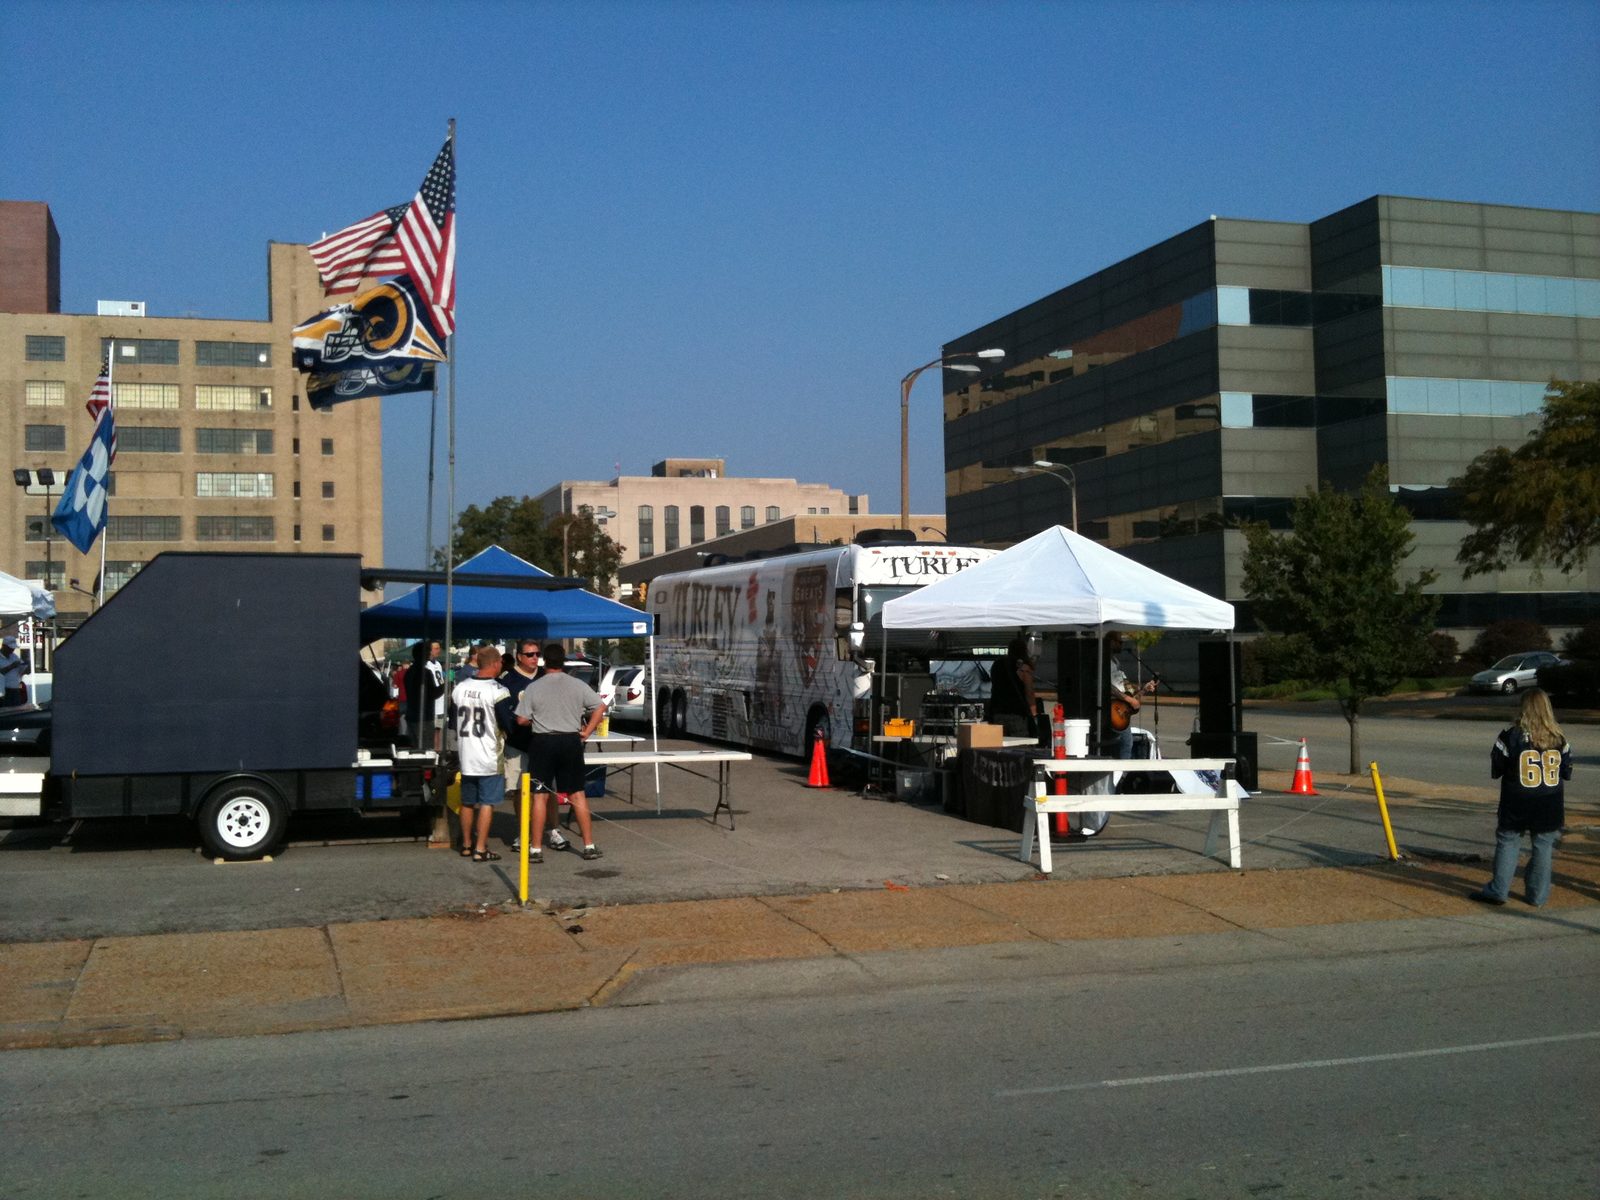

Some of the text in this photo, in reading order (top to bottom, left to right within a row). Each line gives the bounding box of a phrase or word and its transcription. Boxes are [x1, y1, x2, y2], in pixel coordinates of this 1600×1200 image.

[883, 556, 980, 578] TURLE
[458, 705, 486, 738] 28
[1519, 749, 1562, 788] 68
